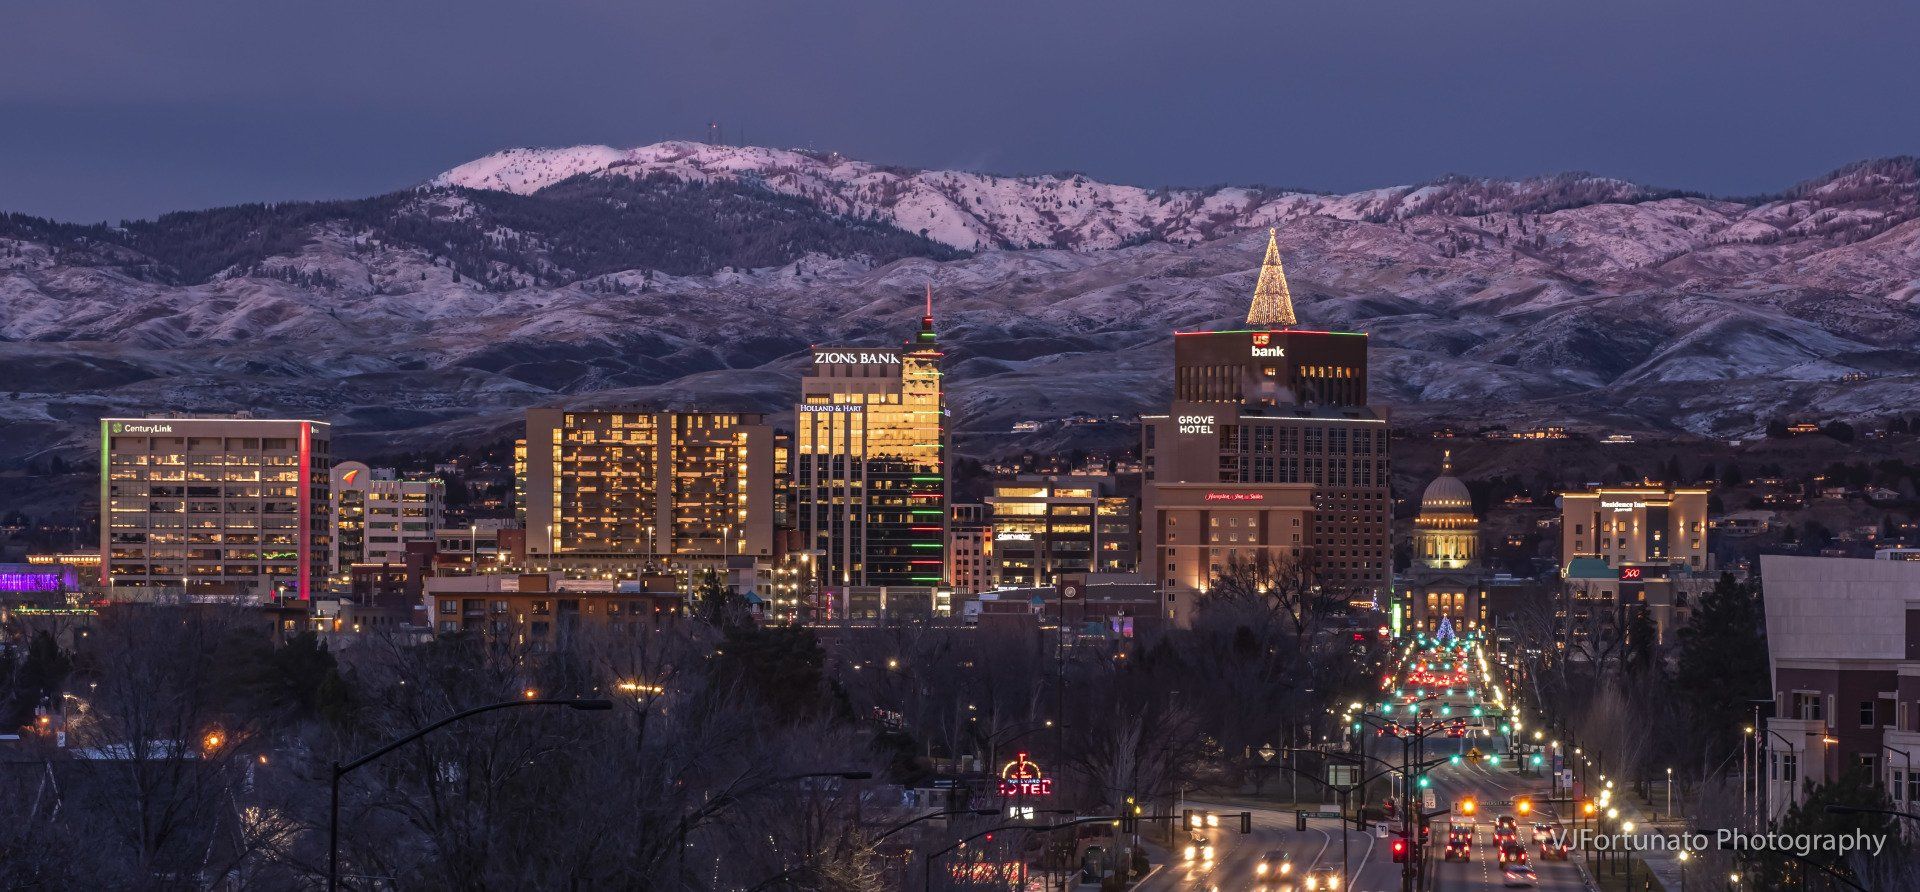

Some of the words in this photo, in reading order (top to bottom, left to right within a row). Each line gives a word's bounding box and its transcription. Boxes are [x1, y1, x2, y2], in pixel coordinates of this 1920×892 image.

[1251, 345, 1285, 357] bank
[814, 352, 857, 364] ZIONS
[860, 352, 901, 364] BANK
[800, 404, 833, 412] HOLLAND
[1178, 415, 1215, 424] GROVE
[124, 424, 173, 433] CenturyLink
[1179, 425, 1214, 434] HOTEL
[997, 532, 1032, 541] clearwater
[1622, 568, 1640, 579] 500
